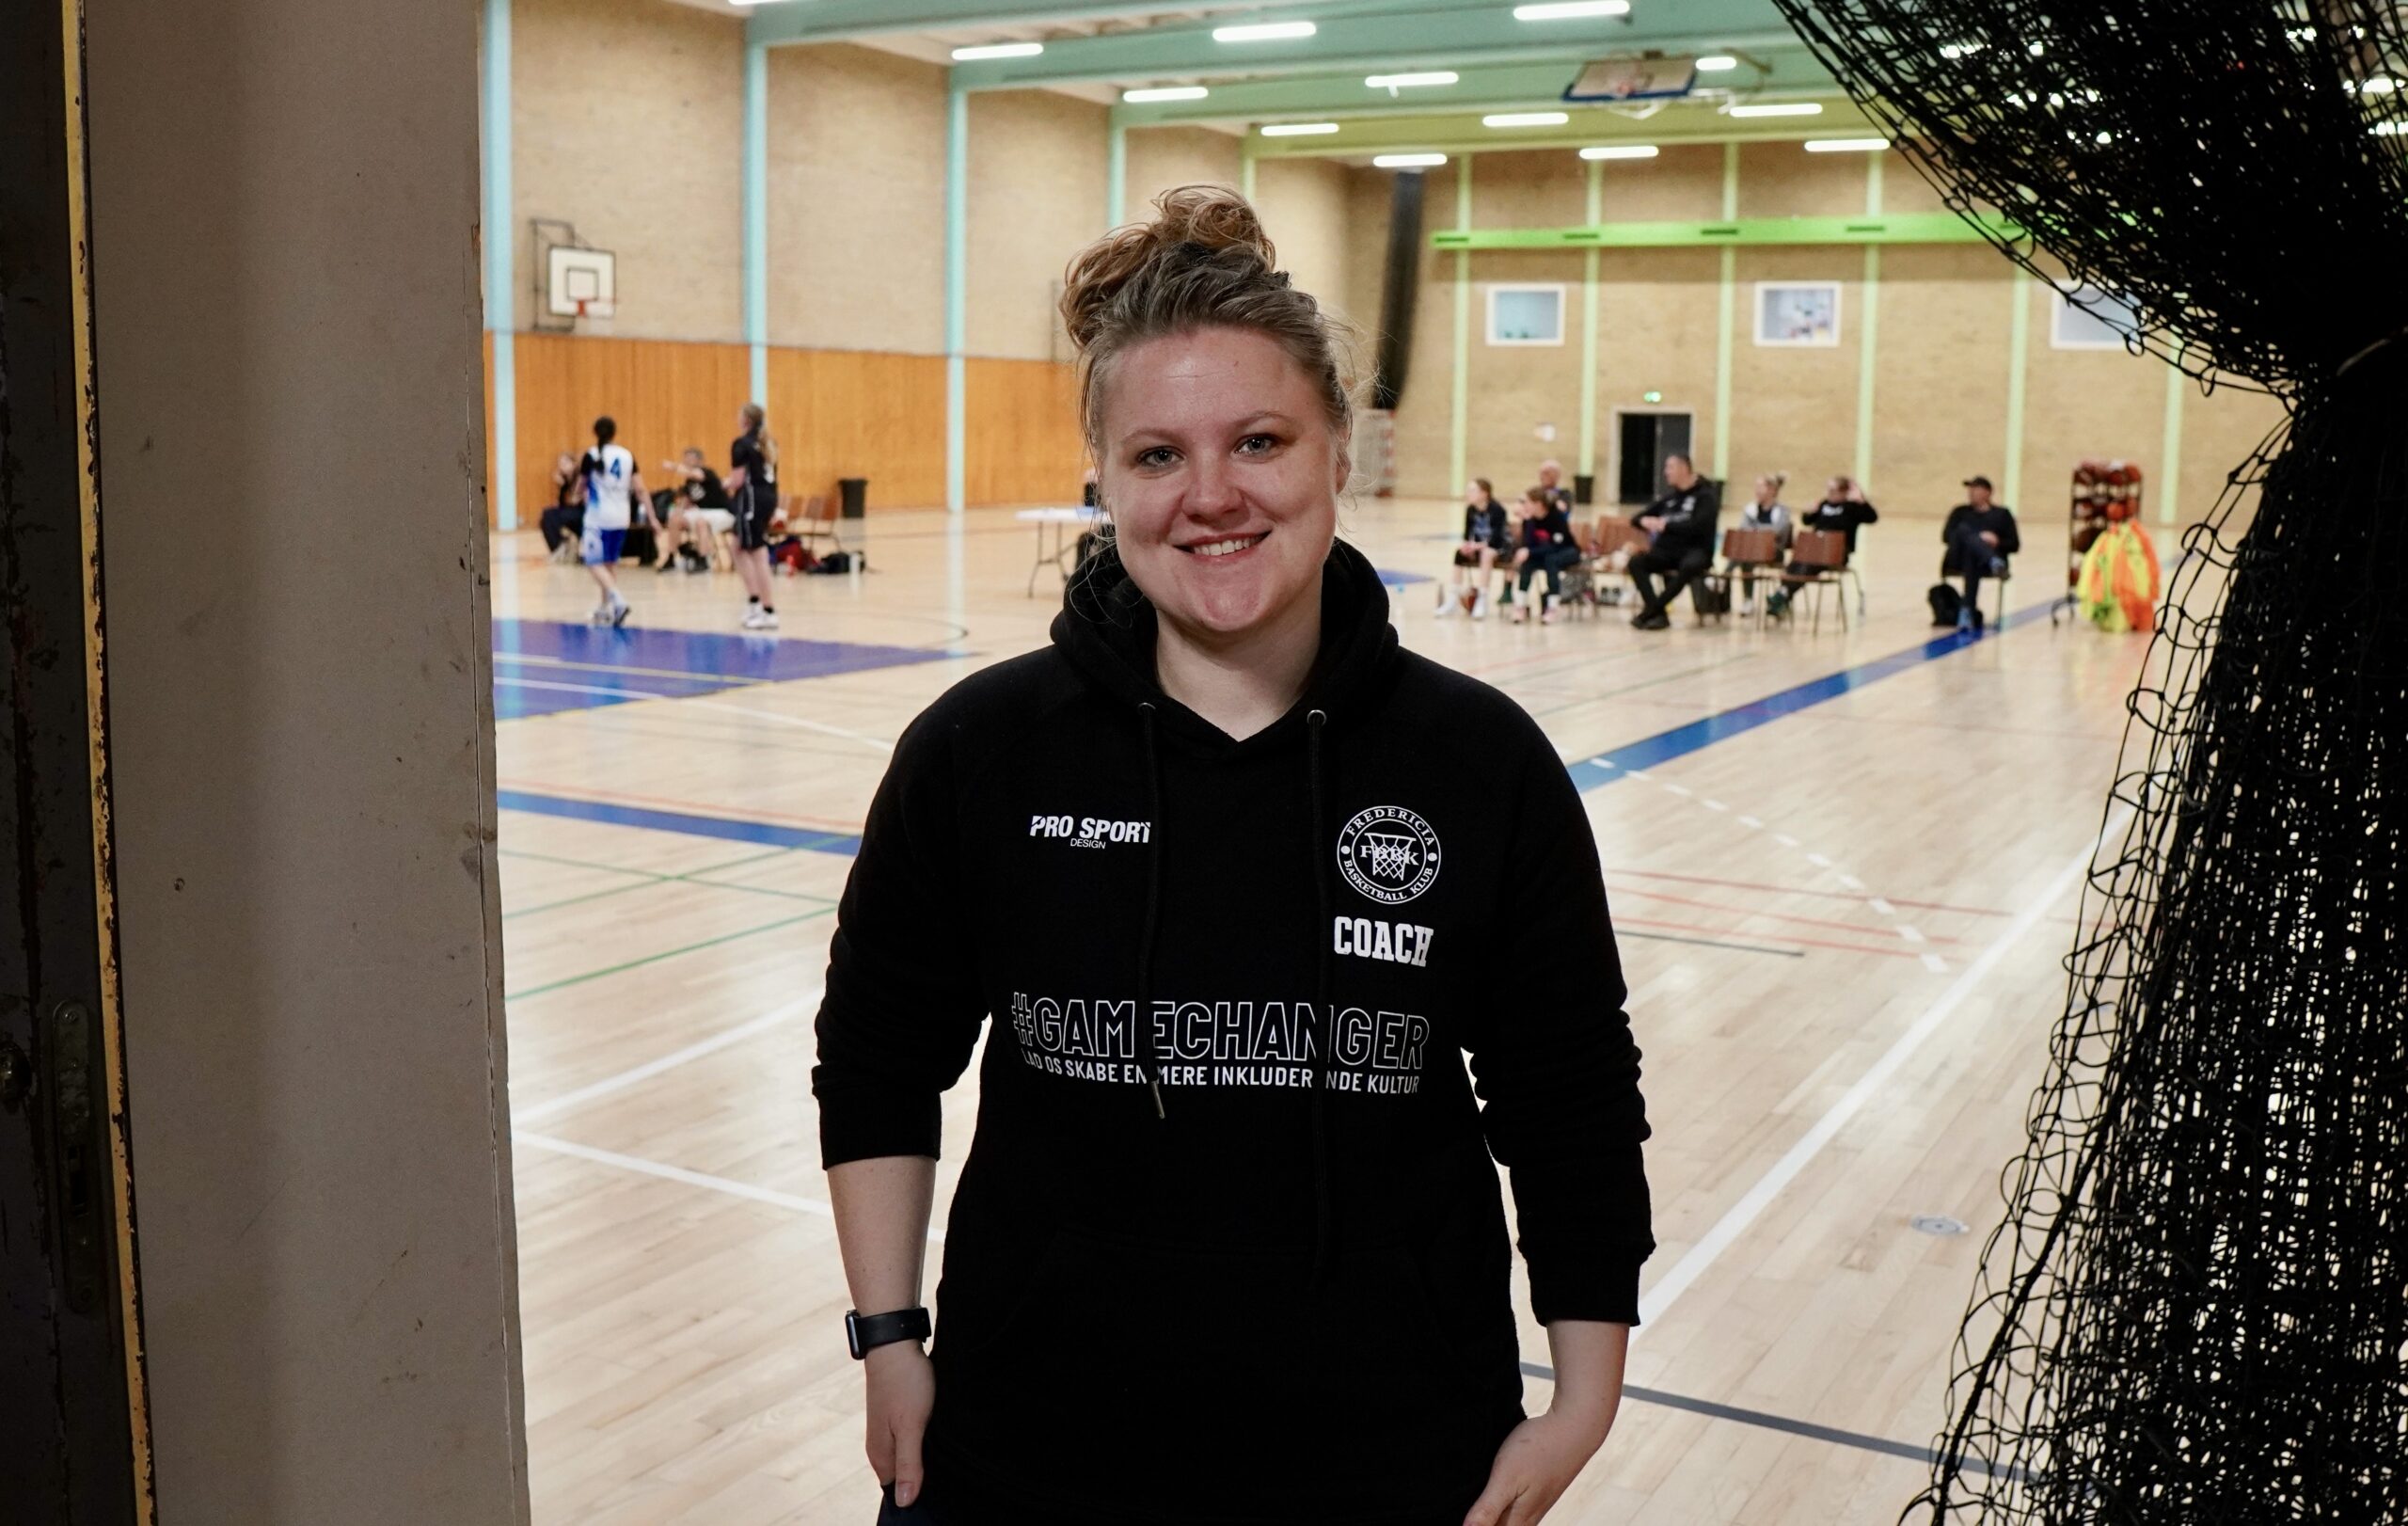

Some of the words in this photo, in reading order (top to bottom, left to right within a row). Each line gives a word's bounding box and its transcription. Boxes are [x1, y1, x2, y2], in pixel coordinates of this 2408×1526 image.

[610, 457, 621, 480] 4
[1030, 816, 1074, 837] PRO
[1079, 818, 1150, 843] SPORT
[1069, 838, 1106, 849] DESIGN
[1346, 809, 1435, 846] FREDERICIA
[1344, 860, 1407, 900] BASKETBALL
[1410, 867, 1434, 895] KLUB
[1334, 916, 1434, 967] COACH
[1011, 992, 1430, 1070] #GAMECHANGER
[1045, 1056, 1063, 1075] OS
[1065, 1059, 1118, 1083] SKABE
[1124, 1064, 1148, 1085] EN
[1157, 1065, 1208, 1086] MERE
[1213, 1066, 1363, 1091] INKLUDERNDE
[1367, 1073, 1420, 1094] KULTUR
